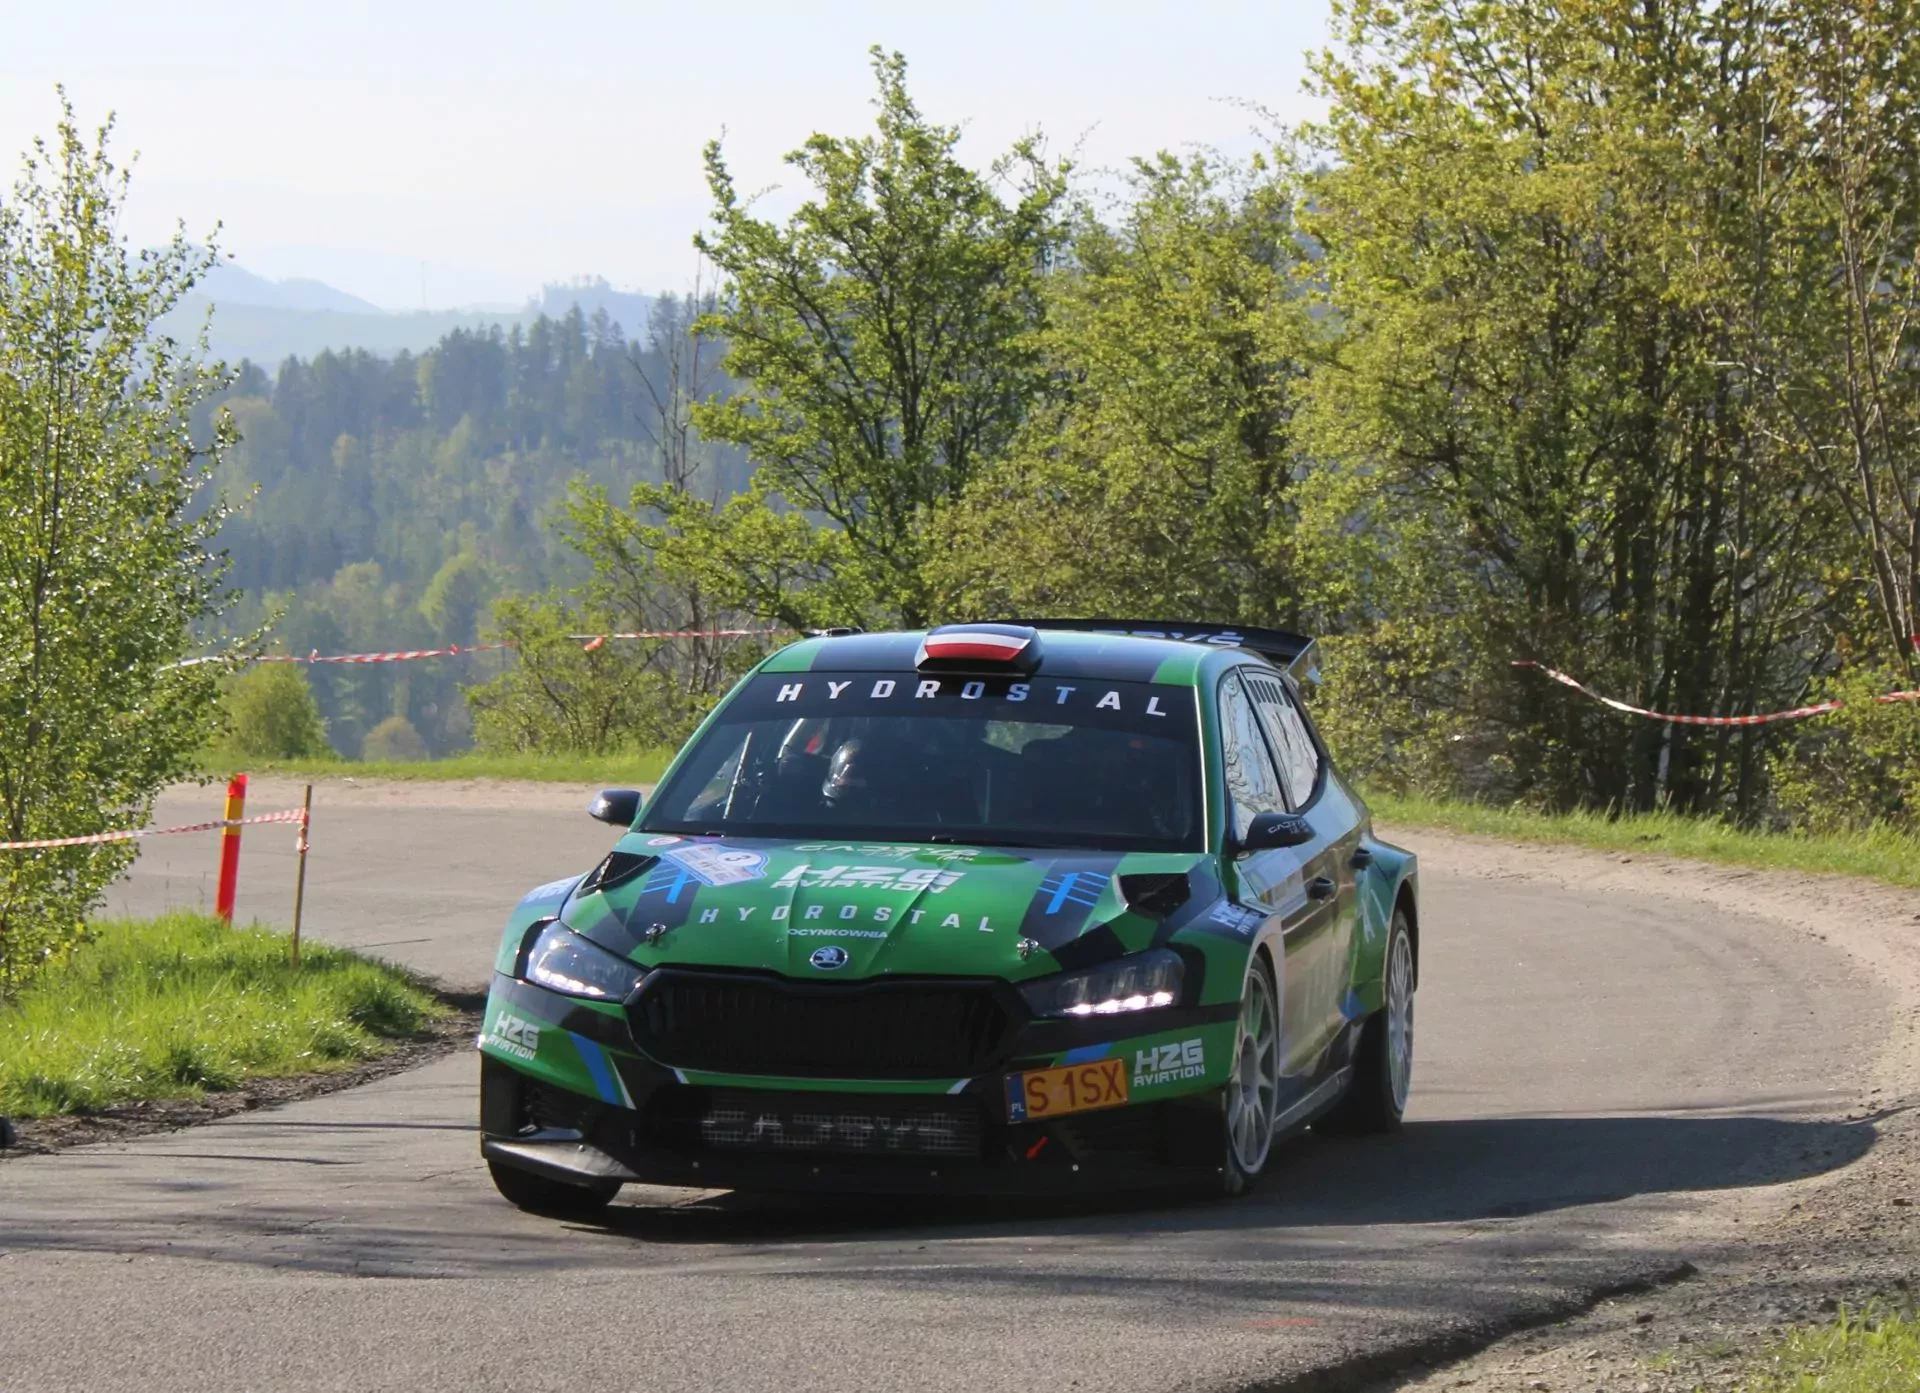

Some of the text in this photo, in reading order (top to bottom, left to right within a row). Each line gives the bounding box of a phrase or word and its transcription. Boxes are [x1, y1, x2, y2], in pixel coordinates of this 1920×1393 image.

[776, 679, 1167, 717] HYDROSTAL
[770, 879, 948, 894] AVIATION
[779, 864, 967, 886] HZG
[699, 905, 995, 933] HYDROSTAL
[787, 928, 888, 939] OCYNKOWNIA
[493, 1010, 540, 1050] HZG
[487, 1033, 537, 1061] AVIATION
[1134, 1038, 1204, 1075] HZG
[1026, 1063, 1123, 1113] S 1SX
[1133, 1064, 1206, 1088] AVIATION
[1011, 1103, 1025, 1113] PL
